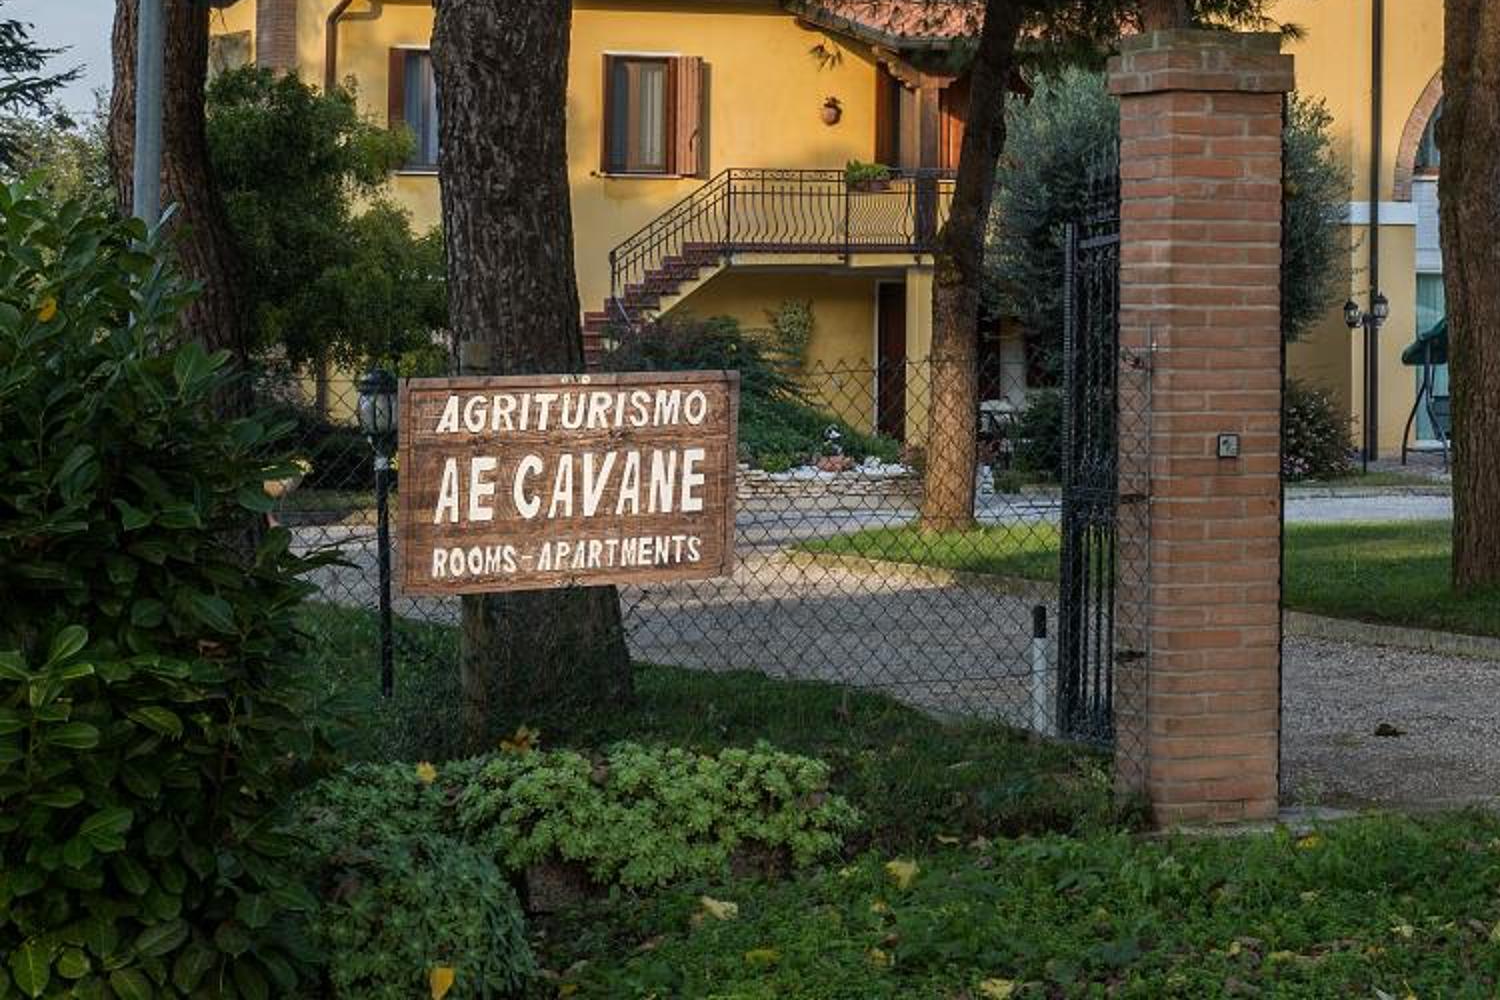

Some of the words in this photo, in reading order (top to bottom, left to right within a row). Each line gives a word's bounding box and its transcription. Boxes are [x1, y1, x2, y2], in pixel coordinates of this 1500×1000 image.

[436, 389, 707, 433] AGRITURISMO
[434, 457, 497, 524] AE
[513, 448, 706, 519] CAVANE
